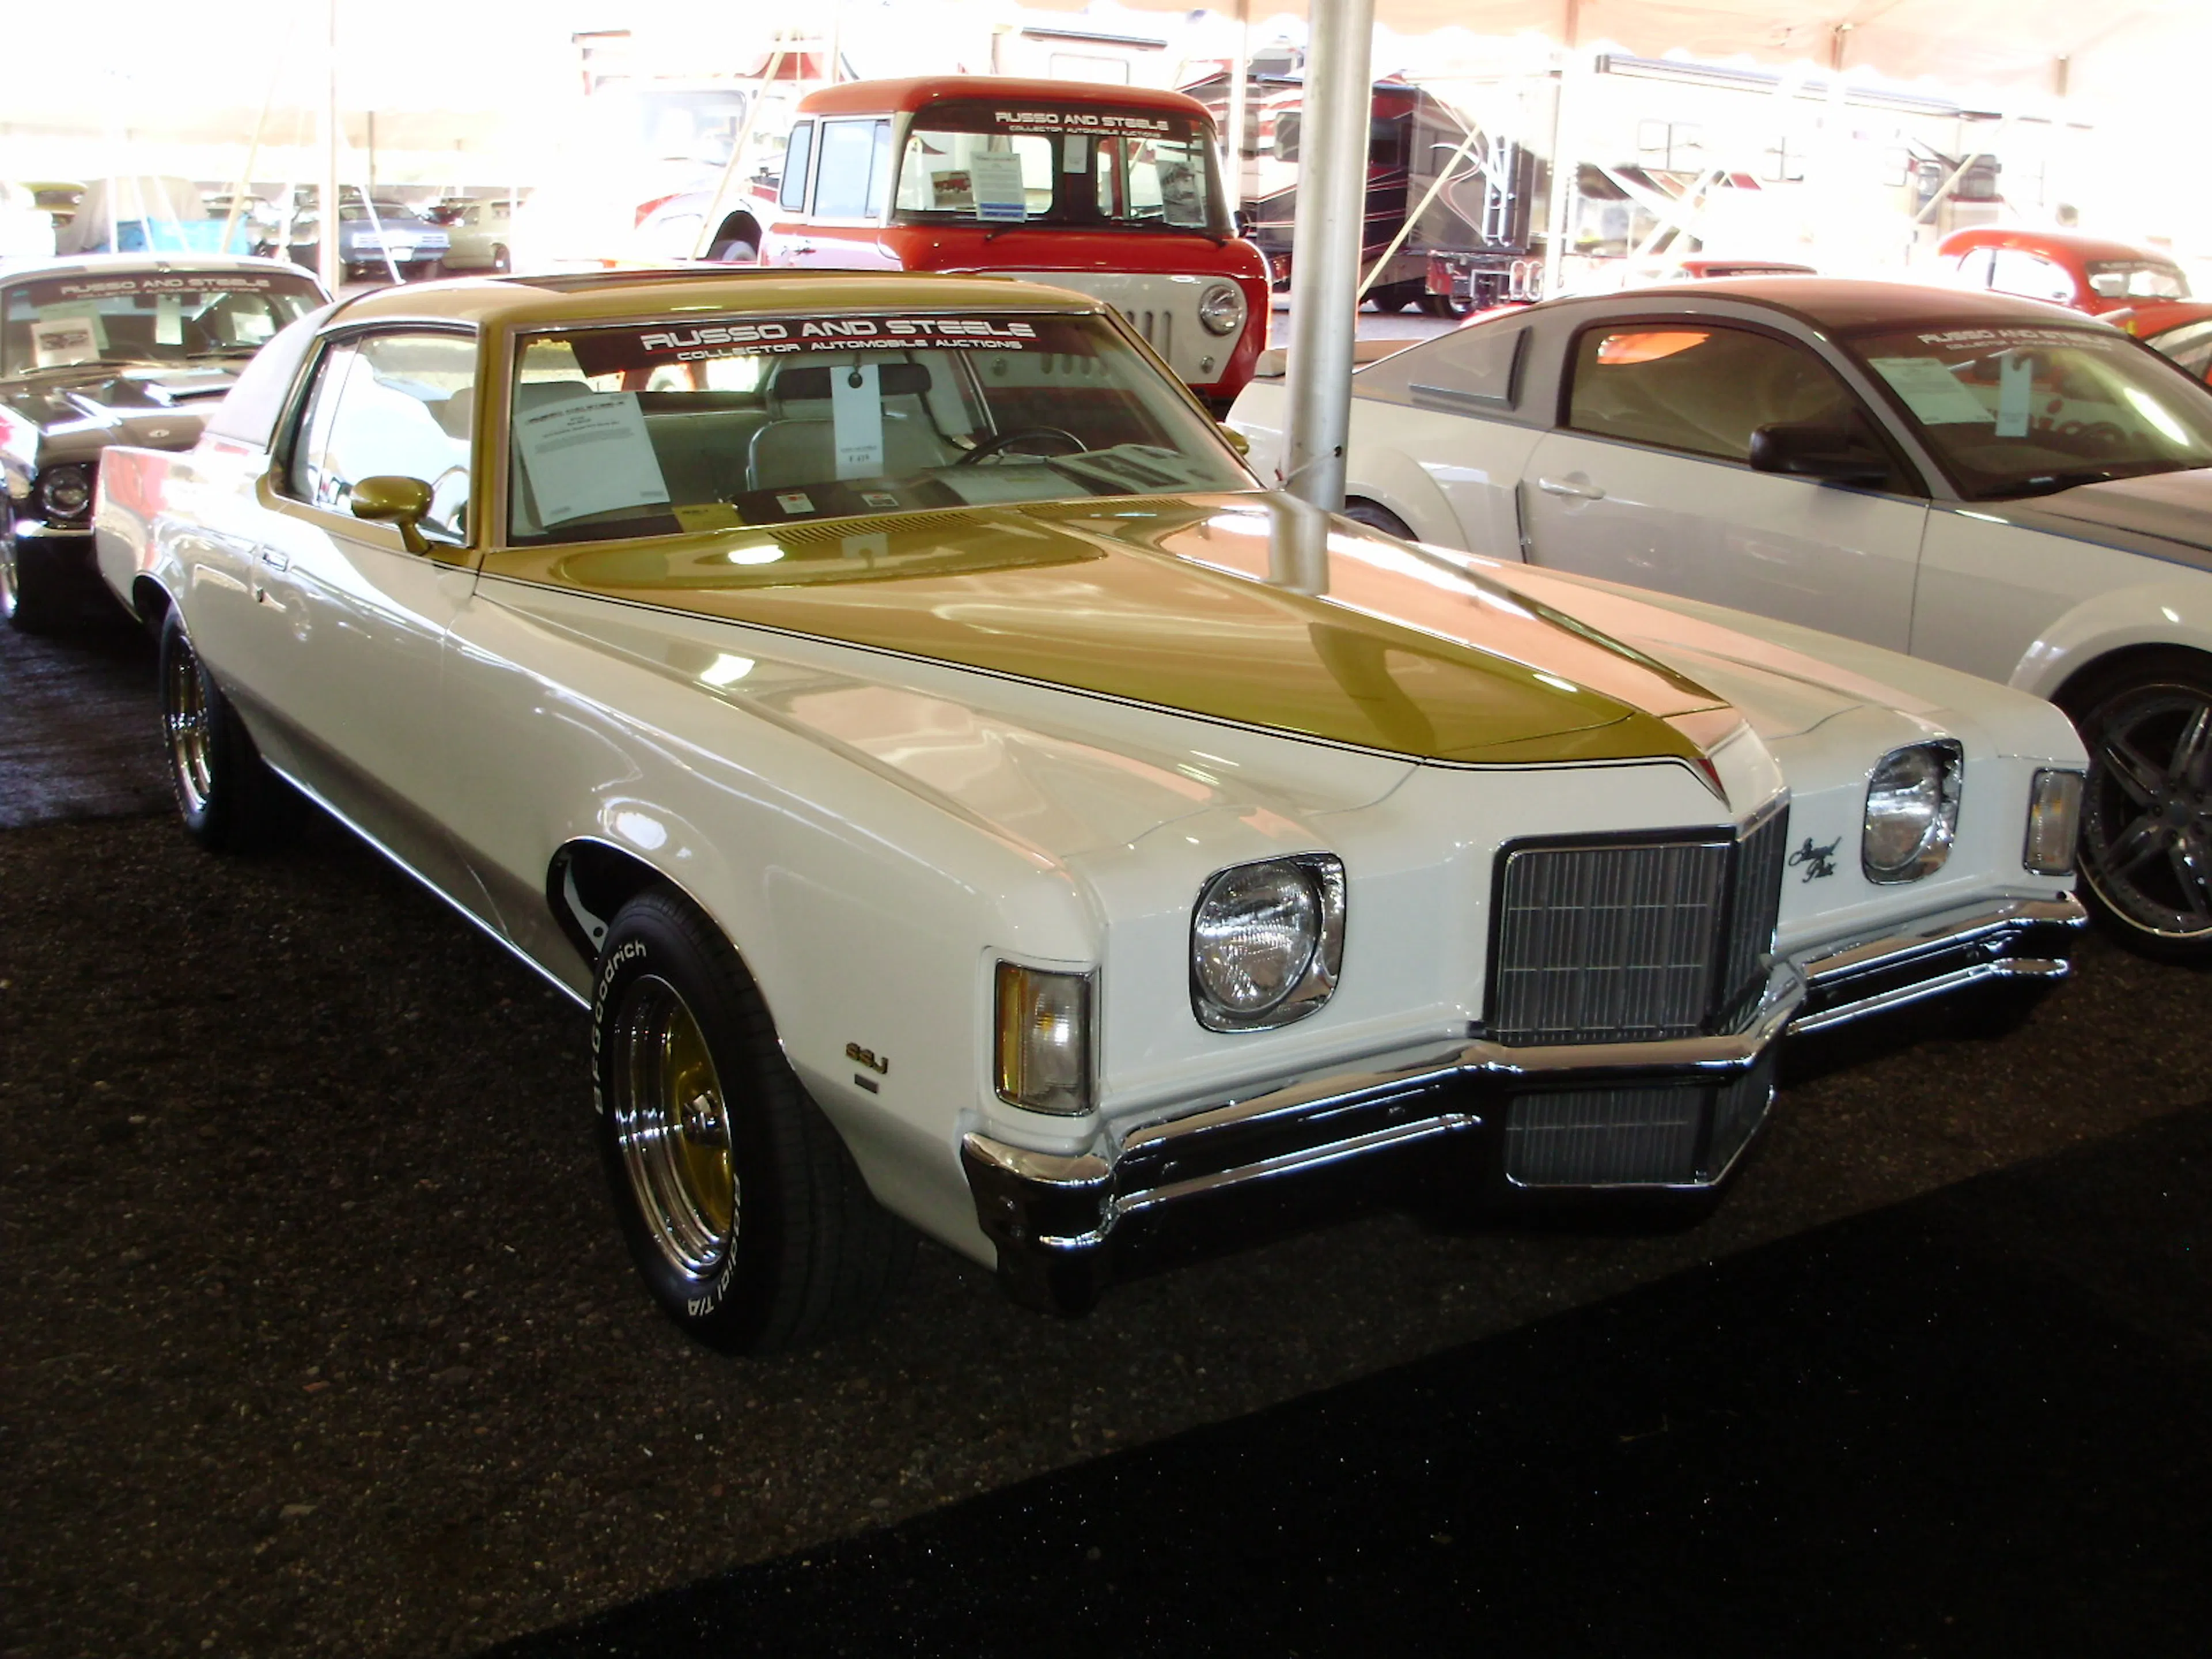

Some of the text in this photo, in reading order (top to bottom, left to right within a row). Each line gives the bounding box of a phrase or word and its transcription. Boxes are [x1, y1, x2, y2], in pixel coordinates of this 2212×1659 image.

[995, 112, 1169, 131] RUSSO AND STEELE
[641, 320, 1037, 351] RUSSO AND STEELE
[677, 339, 1023, 361] COLLECTOR AUTOMOBILE AUCTIONS
[846, 1041, 889, 1075] SSJ
[687, 1295, 715, 1317] T/A
